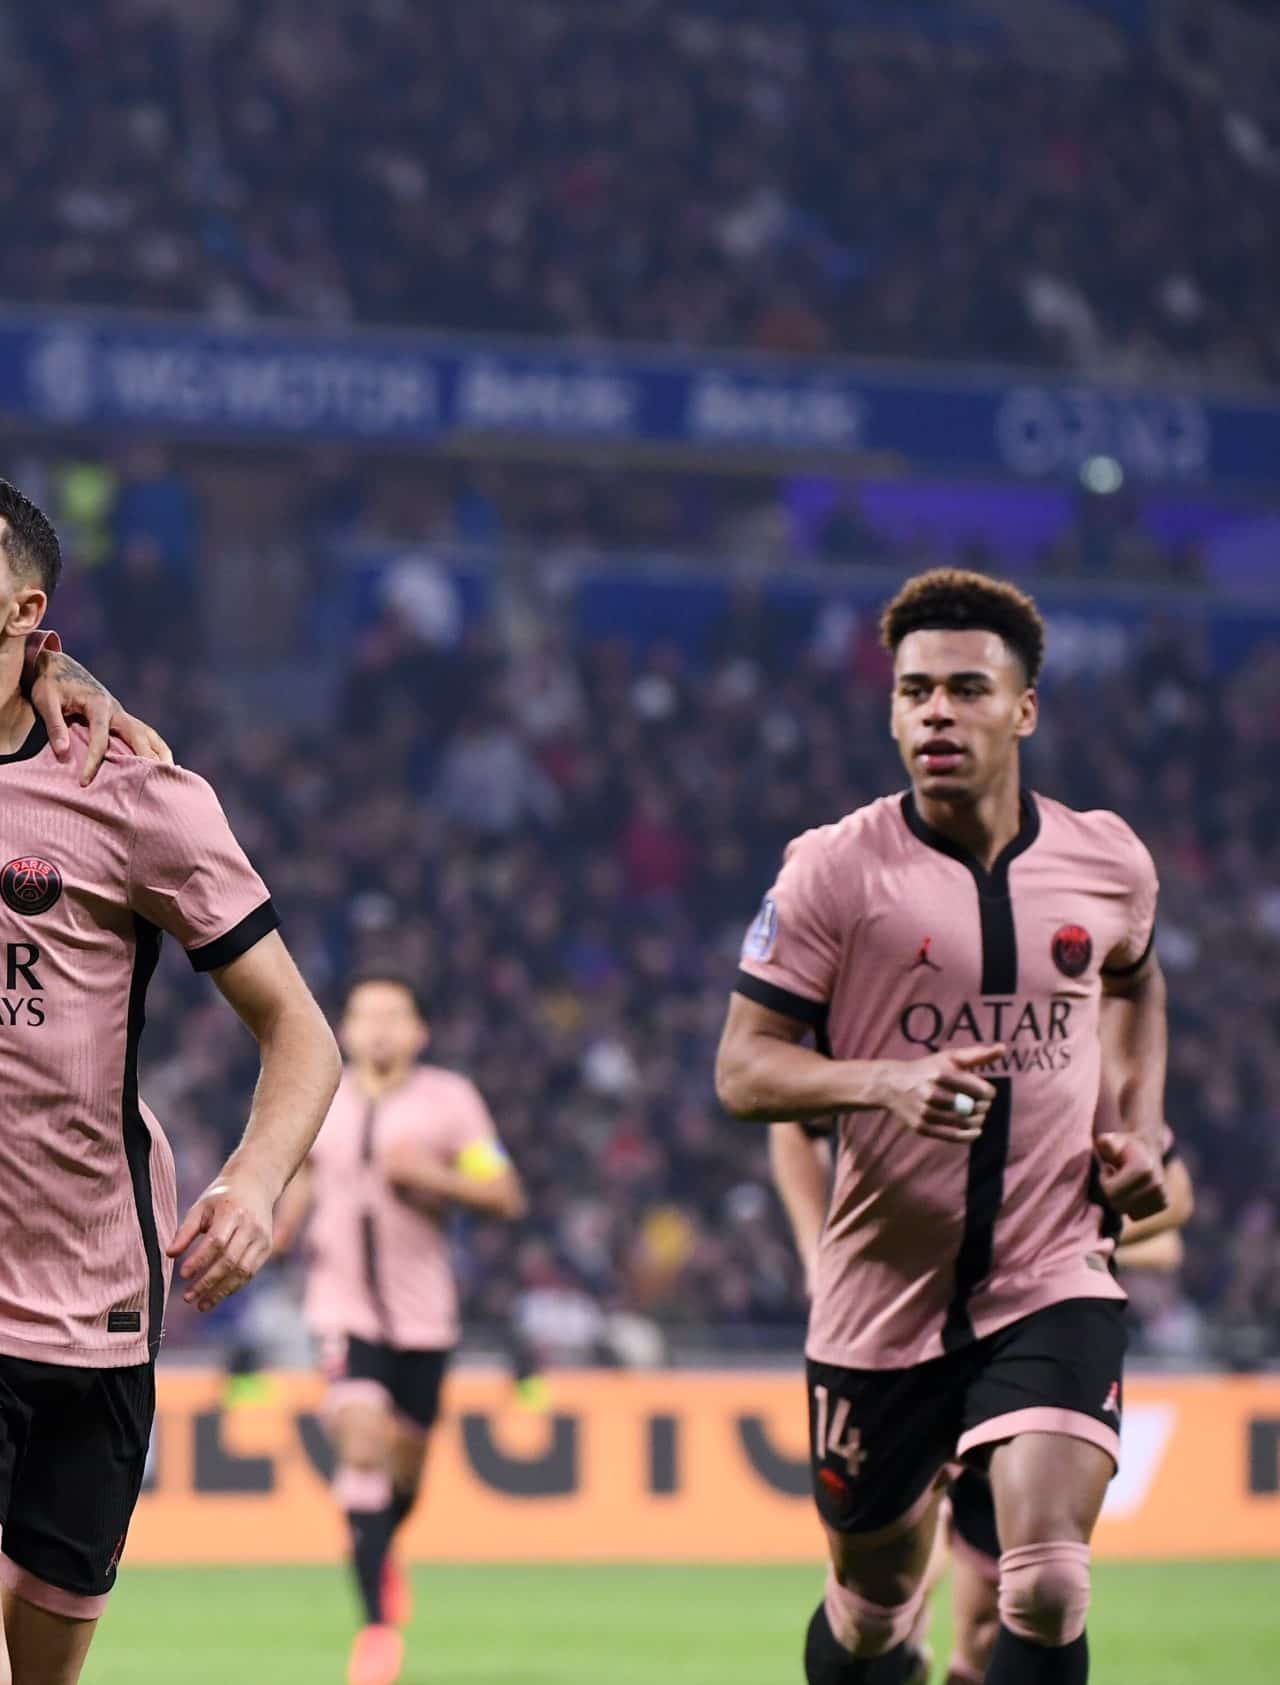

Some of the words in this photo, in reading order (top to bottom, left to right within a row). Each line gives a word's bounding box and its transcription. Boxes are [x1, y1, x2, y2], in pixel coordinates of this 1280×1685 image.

[11, 861, 50, 874] PARIS
[899, 1001, 1072, 1053] QATAR
[814, 1384, 867, 1477] 14
